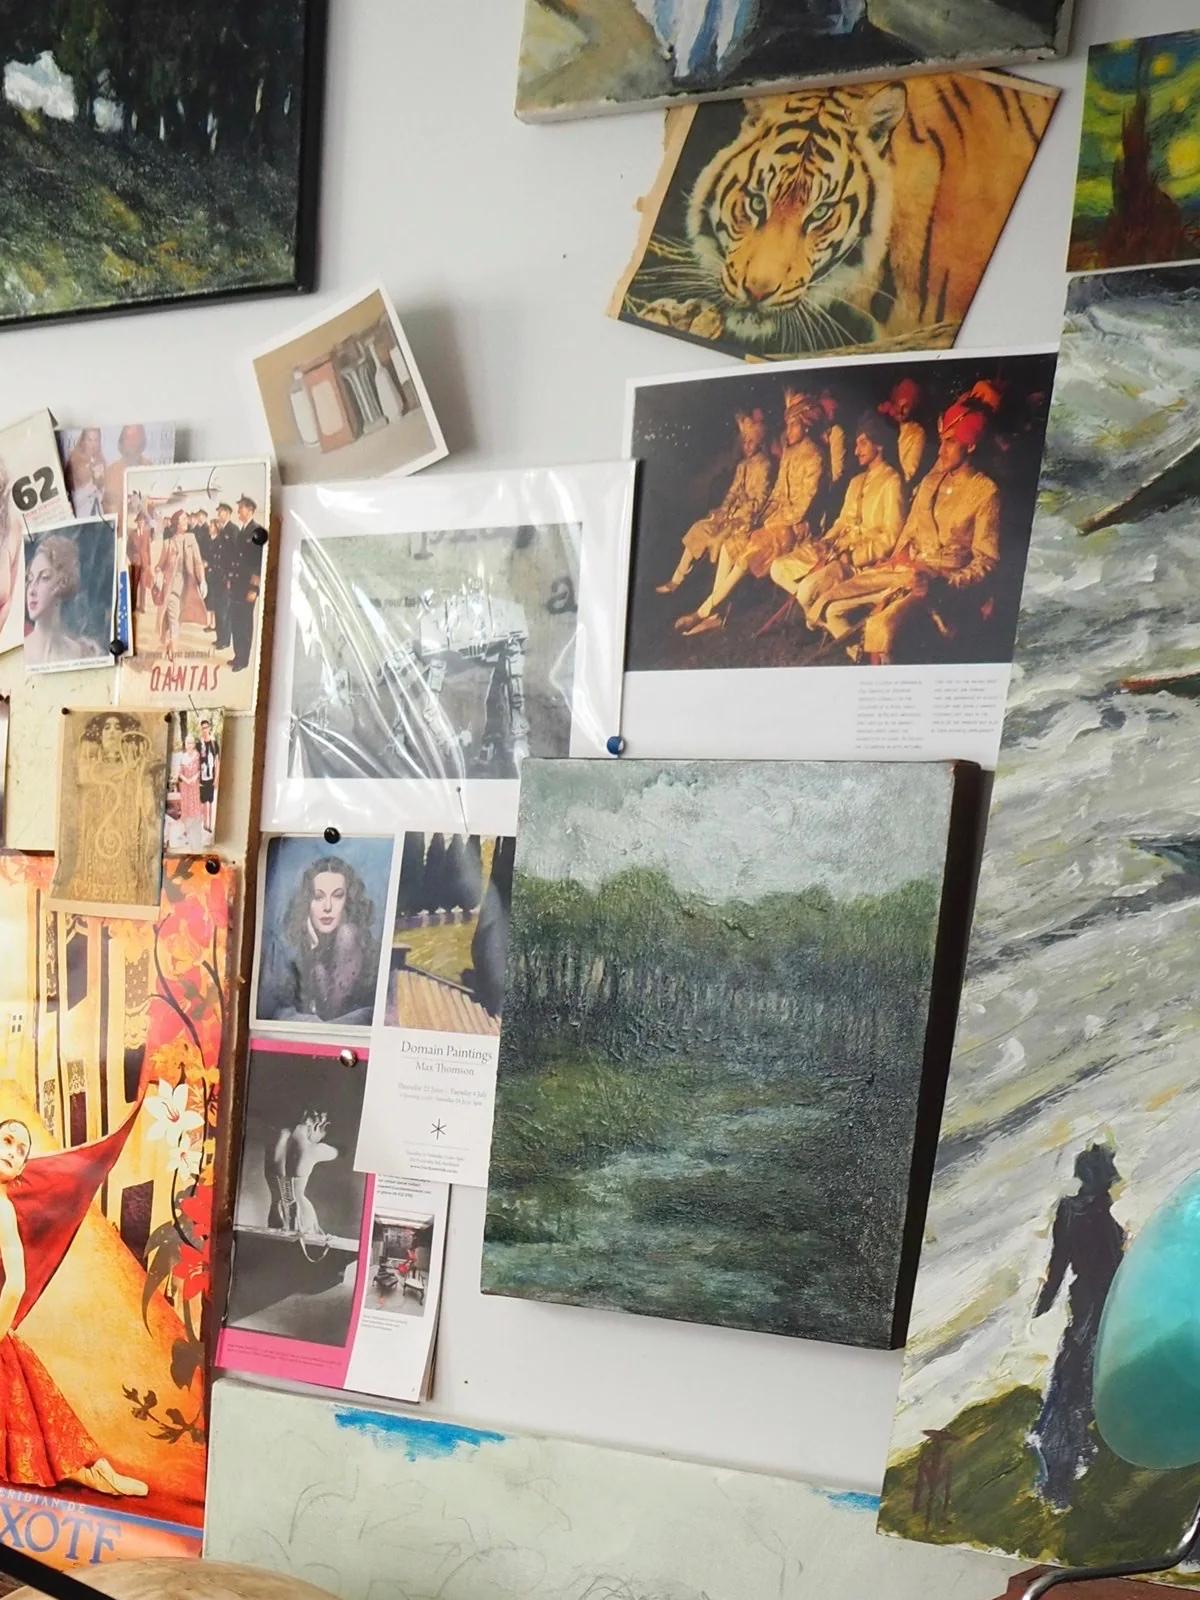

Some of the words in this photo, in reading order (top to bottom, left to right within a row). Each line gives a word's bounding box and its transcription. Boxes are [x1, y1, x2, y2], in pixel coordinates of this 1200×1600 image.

[12, 466, 59, 511] 62
[150, 664, 221, 692] QANTAS
[401, 1040, 444, 1056] Domain
[446, 1045, 493, 1065] Paintings
[415, 1061, 434, 1072] Max
[436, 1063, 475, 1076] Thomson
